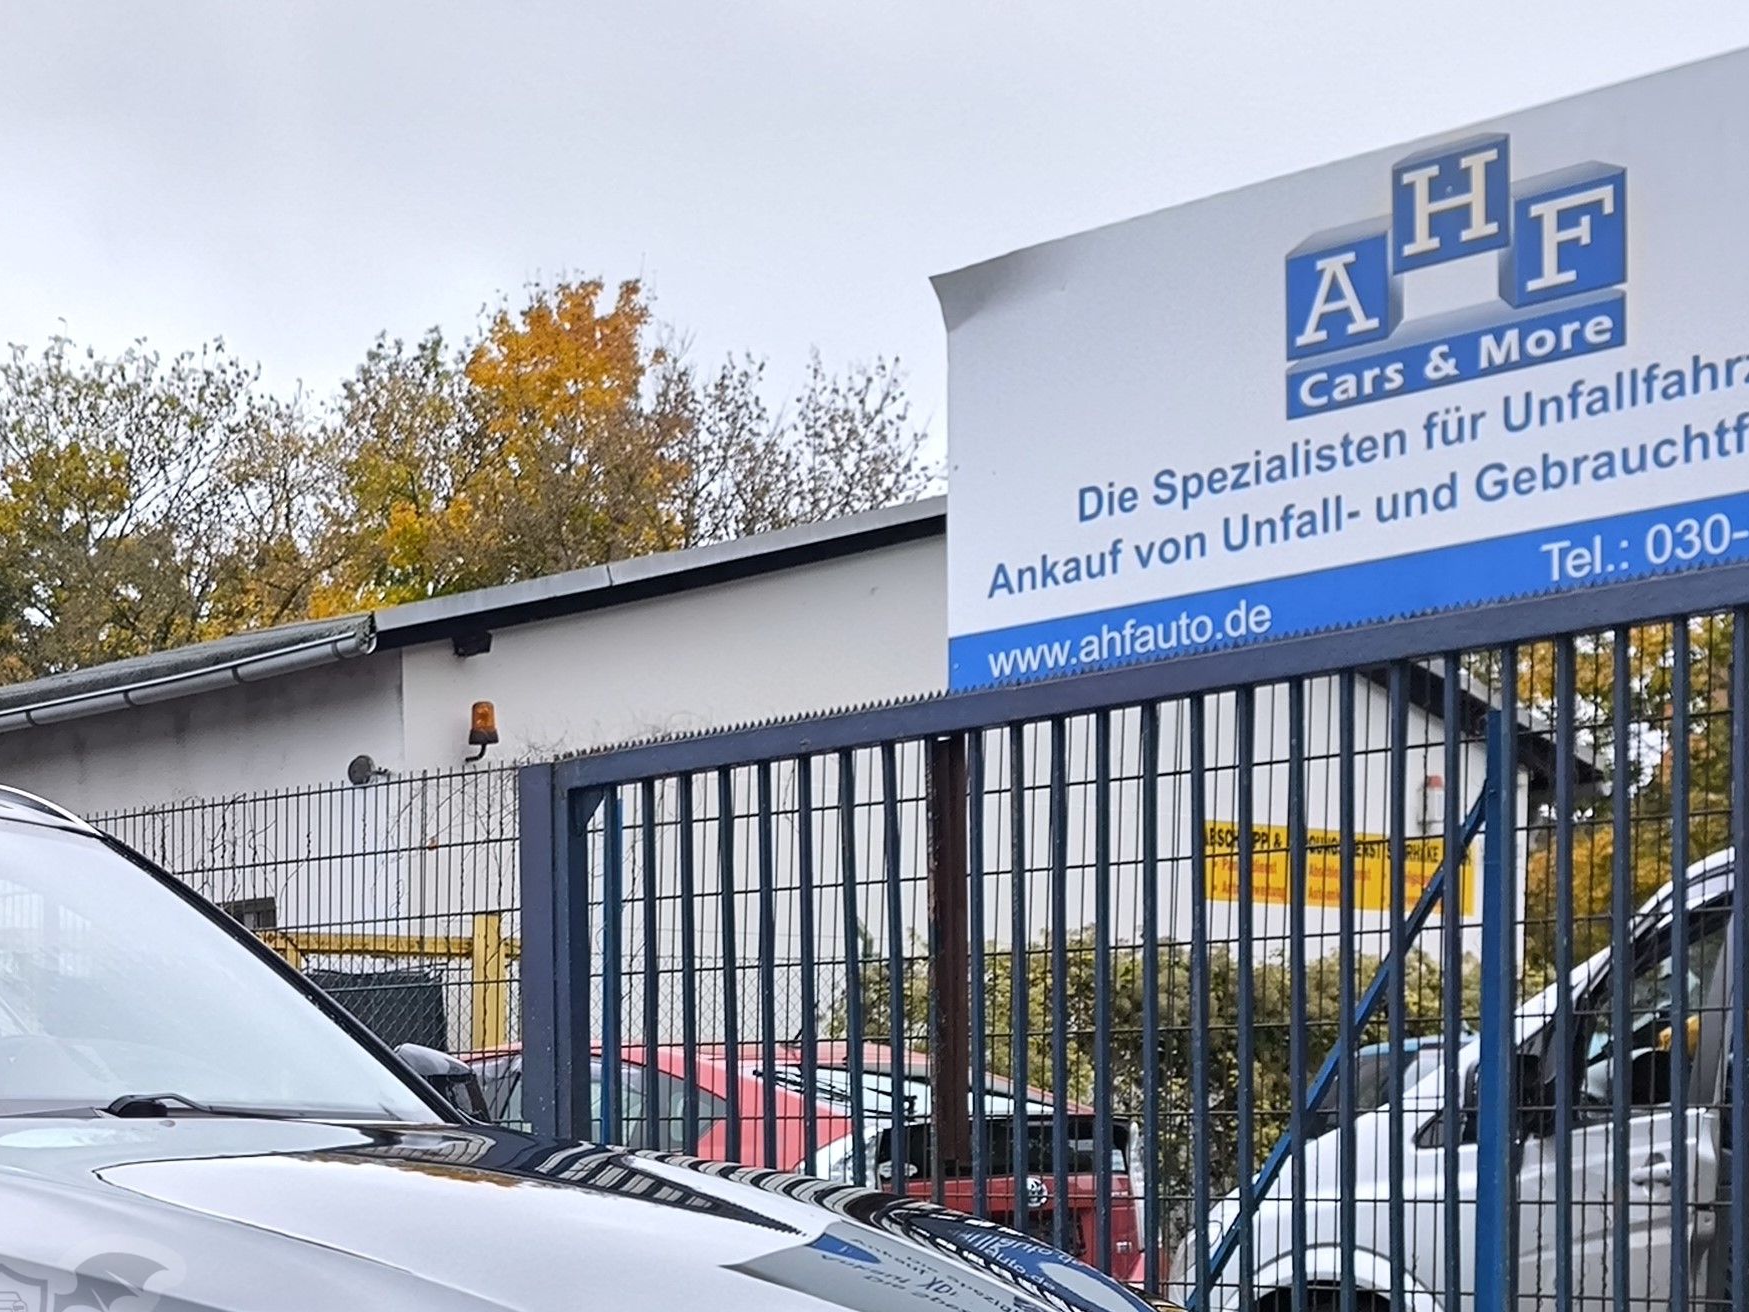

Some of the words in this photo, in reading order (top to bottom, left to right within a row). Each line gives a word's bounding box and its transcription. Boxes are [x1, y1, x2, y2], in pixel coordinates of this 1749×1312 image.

[1299, 364, 1404, 409] Cars
[1424, 345, 1459, 380] &
[1478, 312, 1616, 372] More
[1078, 480, 1139, 523] Die
[1152, 428, 1408, 512] Spezialisten
[1422, 405, 1488, 450] für
[1502, 354, 1749, 433] Unfallfahr
[987, 540, 1124, 599] Ankauf
[1134, 527, 1209, 571] von
[1221, 494, 1362, 555] Unfall-
[1375, 472, 1458, 527] und
[1540, 533, 1630, 582] Tel.:
[988, 597, 1274, 679] www.ahfauto.de
